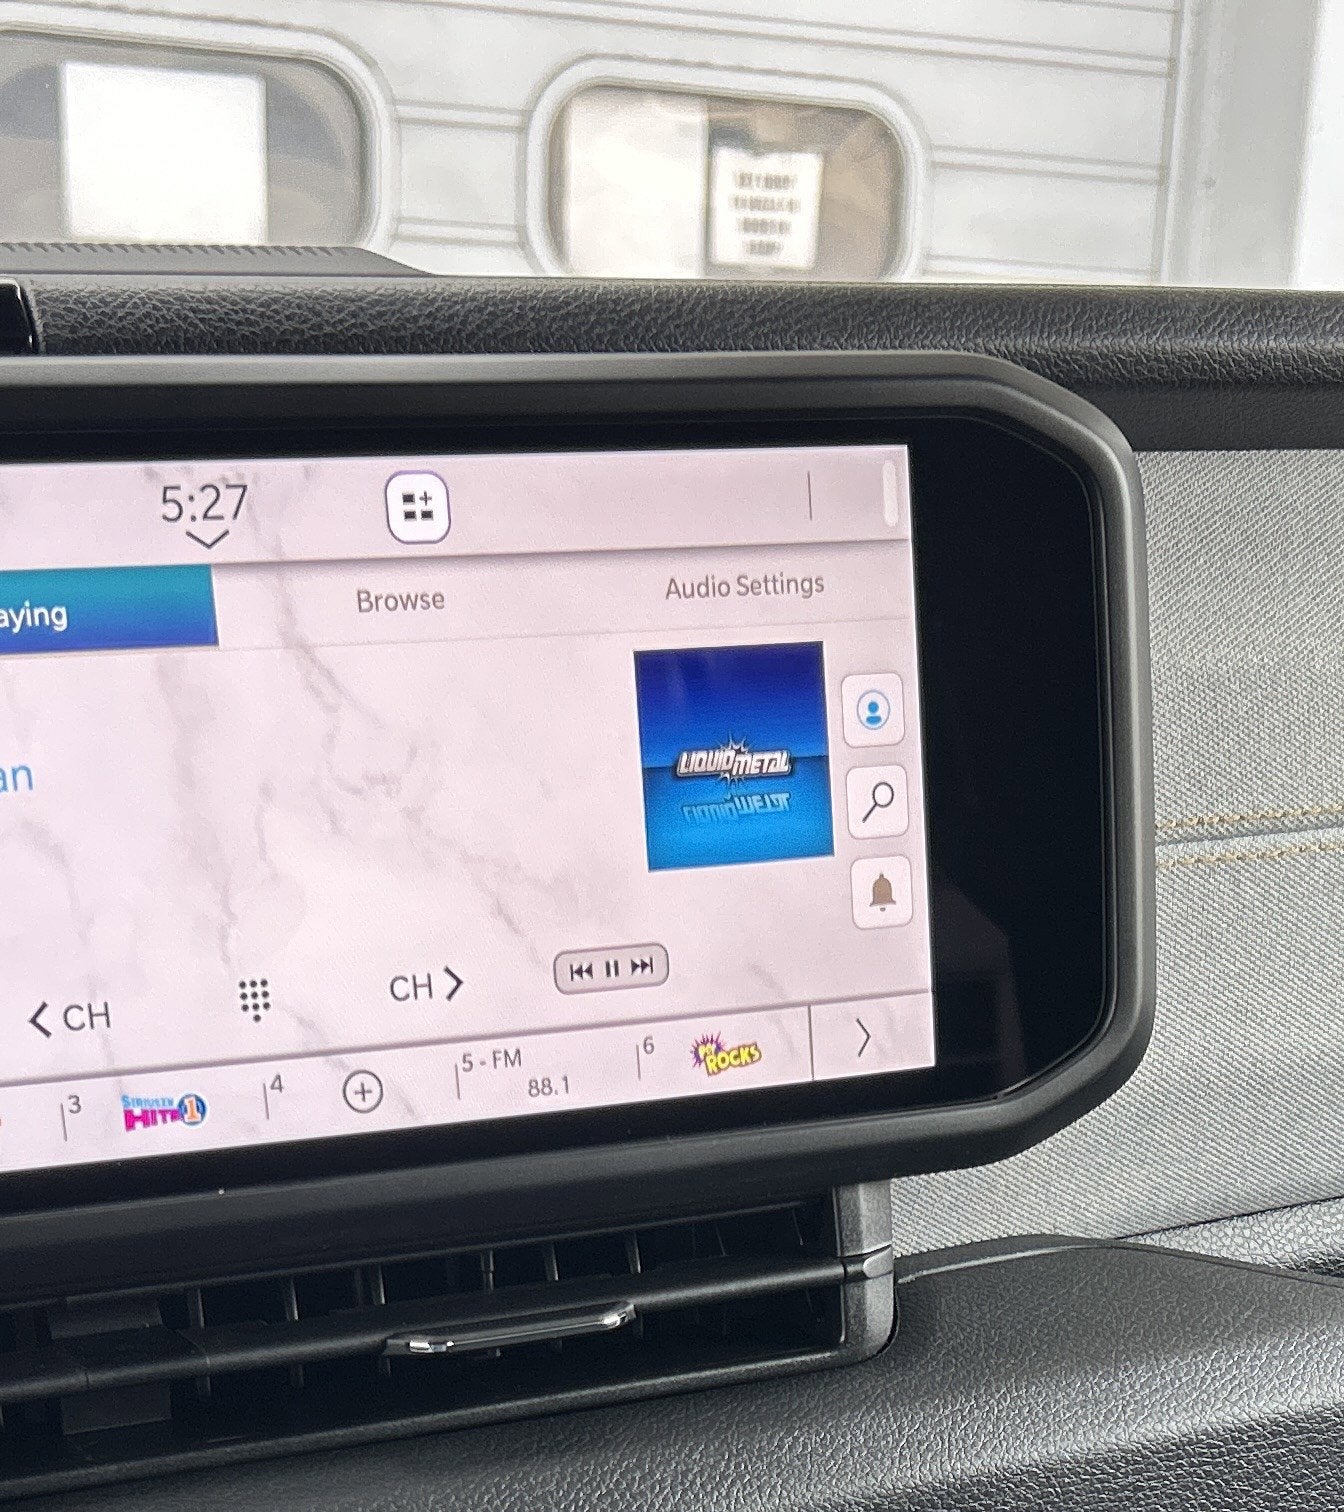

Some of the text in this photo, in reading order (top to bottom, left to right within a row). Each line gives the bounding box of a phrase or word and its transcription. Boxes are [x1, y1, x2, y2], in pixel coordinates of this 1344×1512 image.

[161, 483, 248, 523] 5:27
[666, 573, 825, 600] Audio Settings
[356, 588, 445, 613] Browse
[389, 973, 434, 1002] CH
[62, 1002, 112, 1033] CH
[643, 1036, 655, 1056] 6
[704, 1041, 762, 1076] ROCKS
[461, 1053, 474, 1073] 5
[492, 1049, 523, 1070] FM
[270, 1074, 284, 1094] 4
[527, 1075, 571, 1098] 88.1
[67, 1096, 83, 1115] 3
